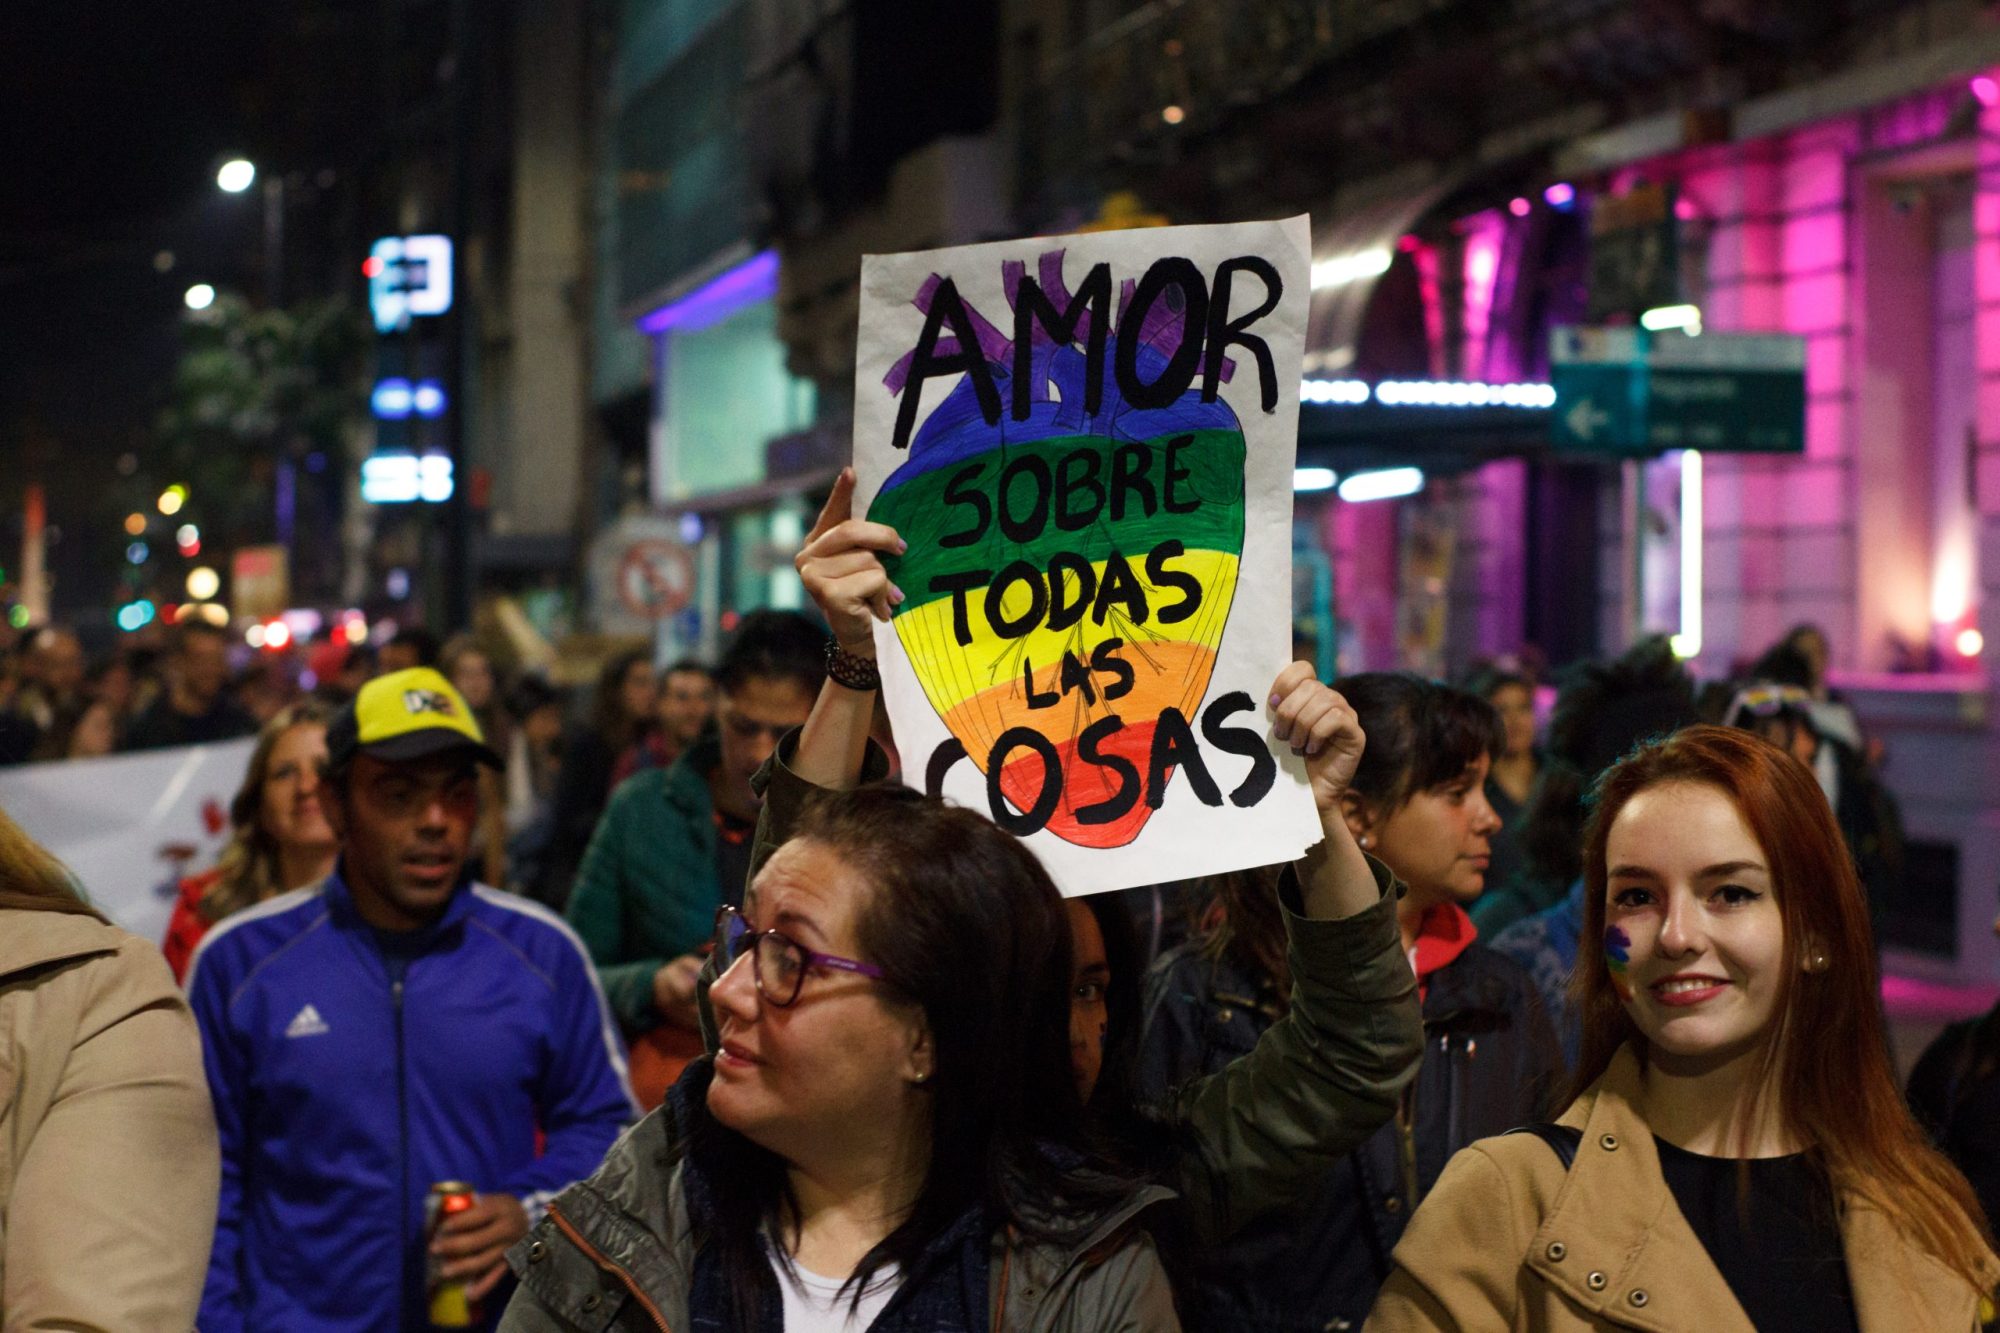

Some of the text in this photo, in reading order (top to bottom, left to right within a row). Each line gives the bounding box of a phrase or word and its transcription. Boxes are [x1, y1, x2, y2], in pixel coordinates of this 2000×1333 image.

[892, 256, 1283, 449] AMOR
[939, 434, 1200, 549] SOBRE
[929, 540, 1203, 646] TODAS
[1023, 638, 1135, 709] LAS
